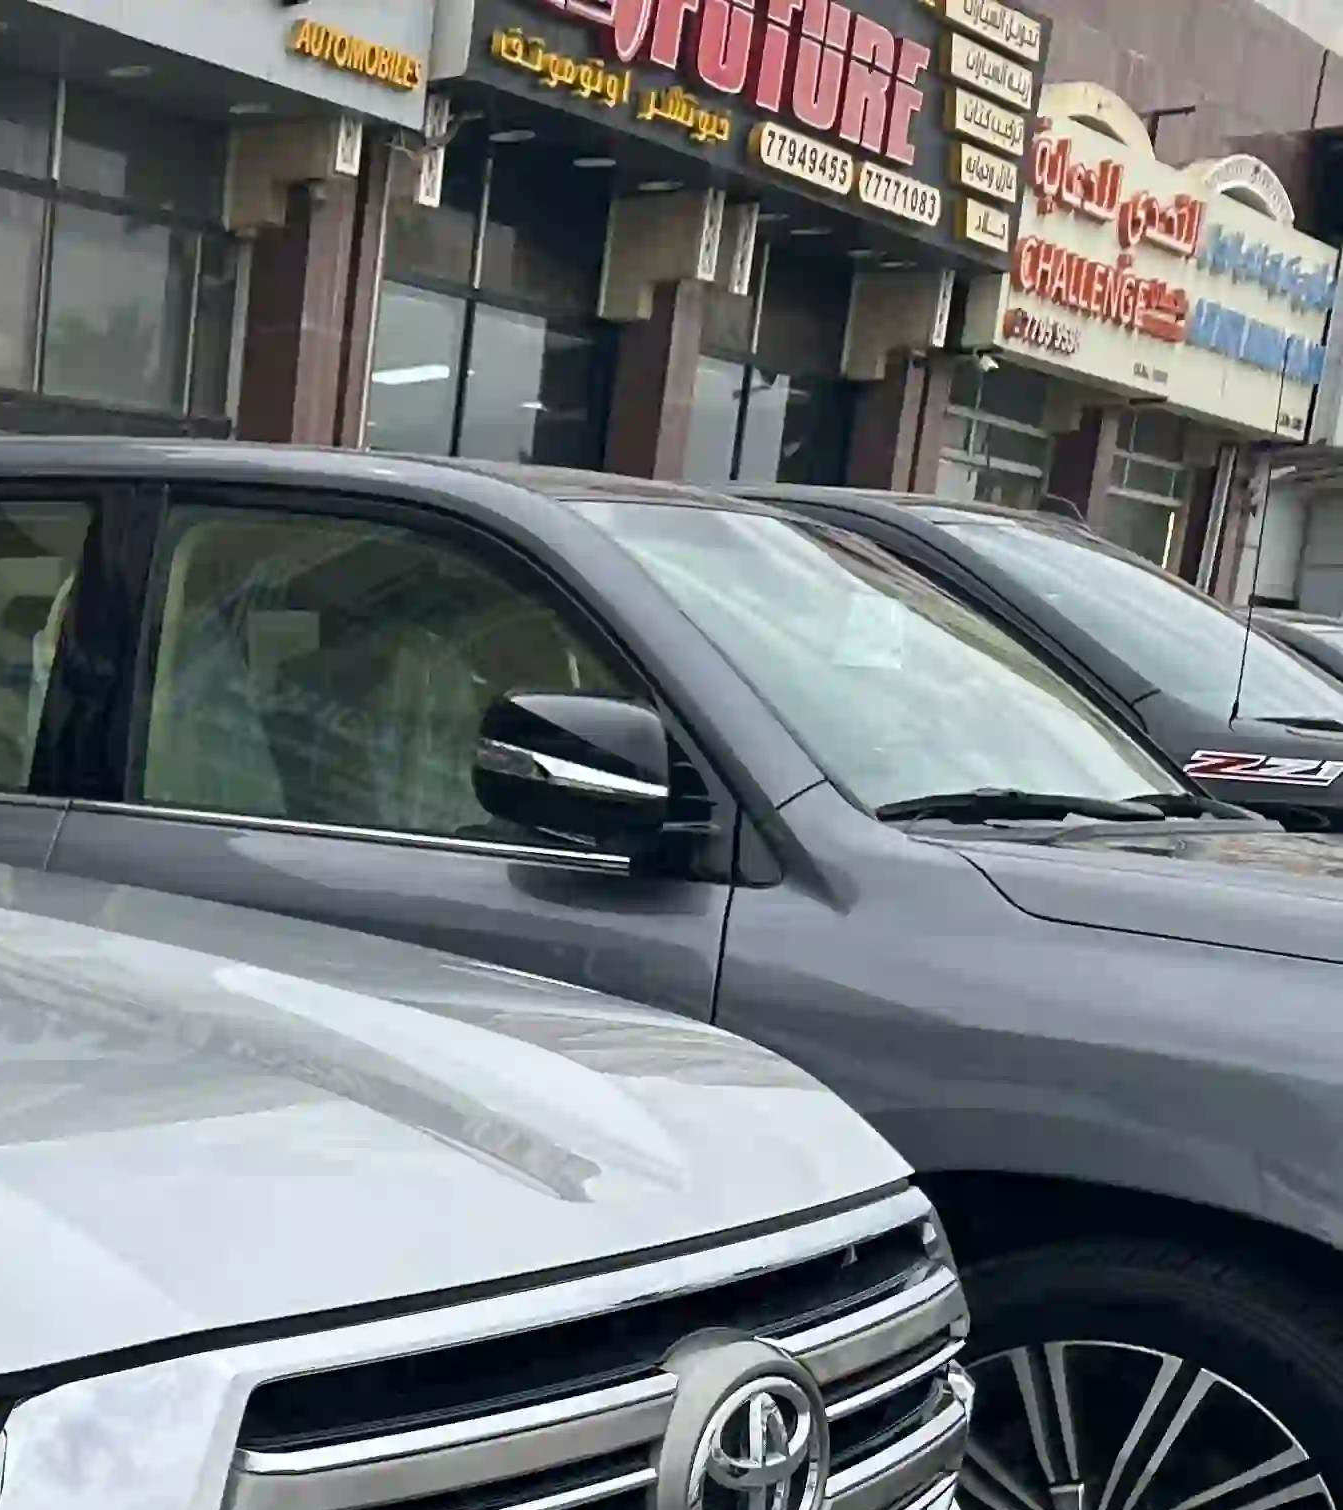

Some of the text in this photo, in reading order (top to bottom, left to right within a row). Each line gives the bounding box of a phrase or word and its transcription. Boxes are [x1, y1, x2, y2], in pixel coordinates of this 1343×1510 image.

[291, 18, 422, 90] AUTOMOBILES
[766, 129, 849, 186] 77949455
[865, 169, 937, 221] 77771083
[1017, 236, 1150, 328] CHALLENGE
